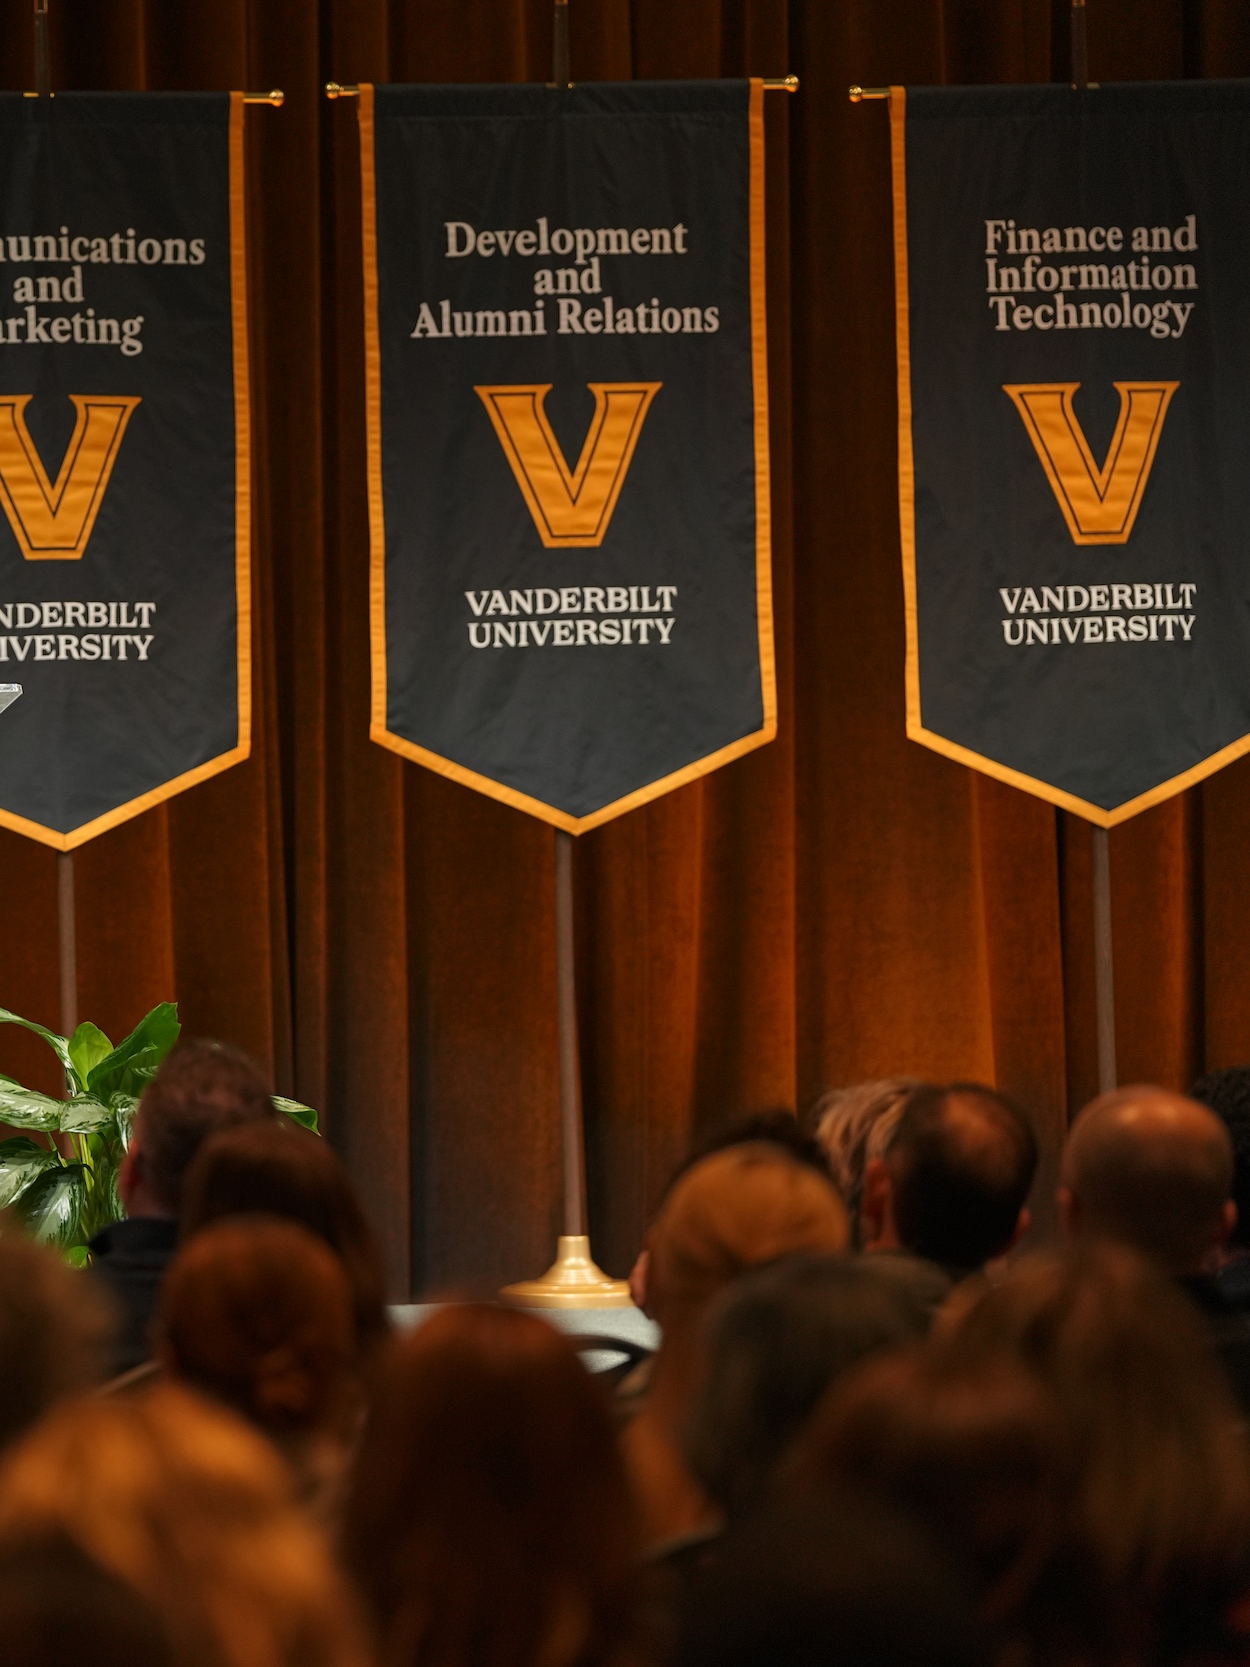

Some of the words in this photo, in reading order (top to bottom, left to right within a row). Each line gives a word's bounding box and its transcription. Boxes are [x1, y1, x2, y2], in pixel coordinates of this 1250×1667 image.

[443, 216, 689, 263] Development
[984, 219, 1125, 255] Finance
[1131, 214, 1199, 253] and
[12, 265, 85, 303] and
[533, 257, 603, 296] and
[985, 255, 1199, 294] Information
[410, 299, 548, 339] Alumni
[555, 295, 721, 336] Relations
[988, 291, 1196, 339] Technology
[473, 381, 663, 548] V
[1001, 380, 1181, 546] V
[464, 585, 678, 617] VANDERBILT
[998, 582, 1197, 615] VANDERBILT
[467, 617, 676, 649] UNIVERSITY
[1001, 613, 1197, 646] UNIVERSITY
